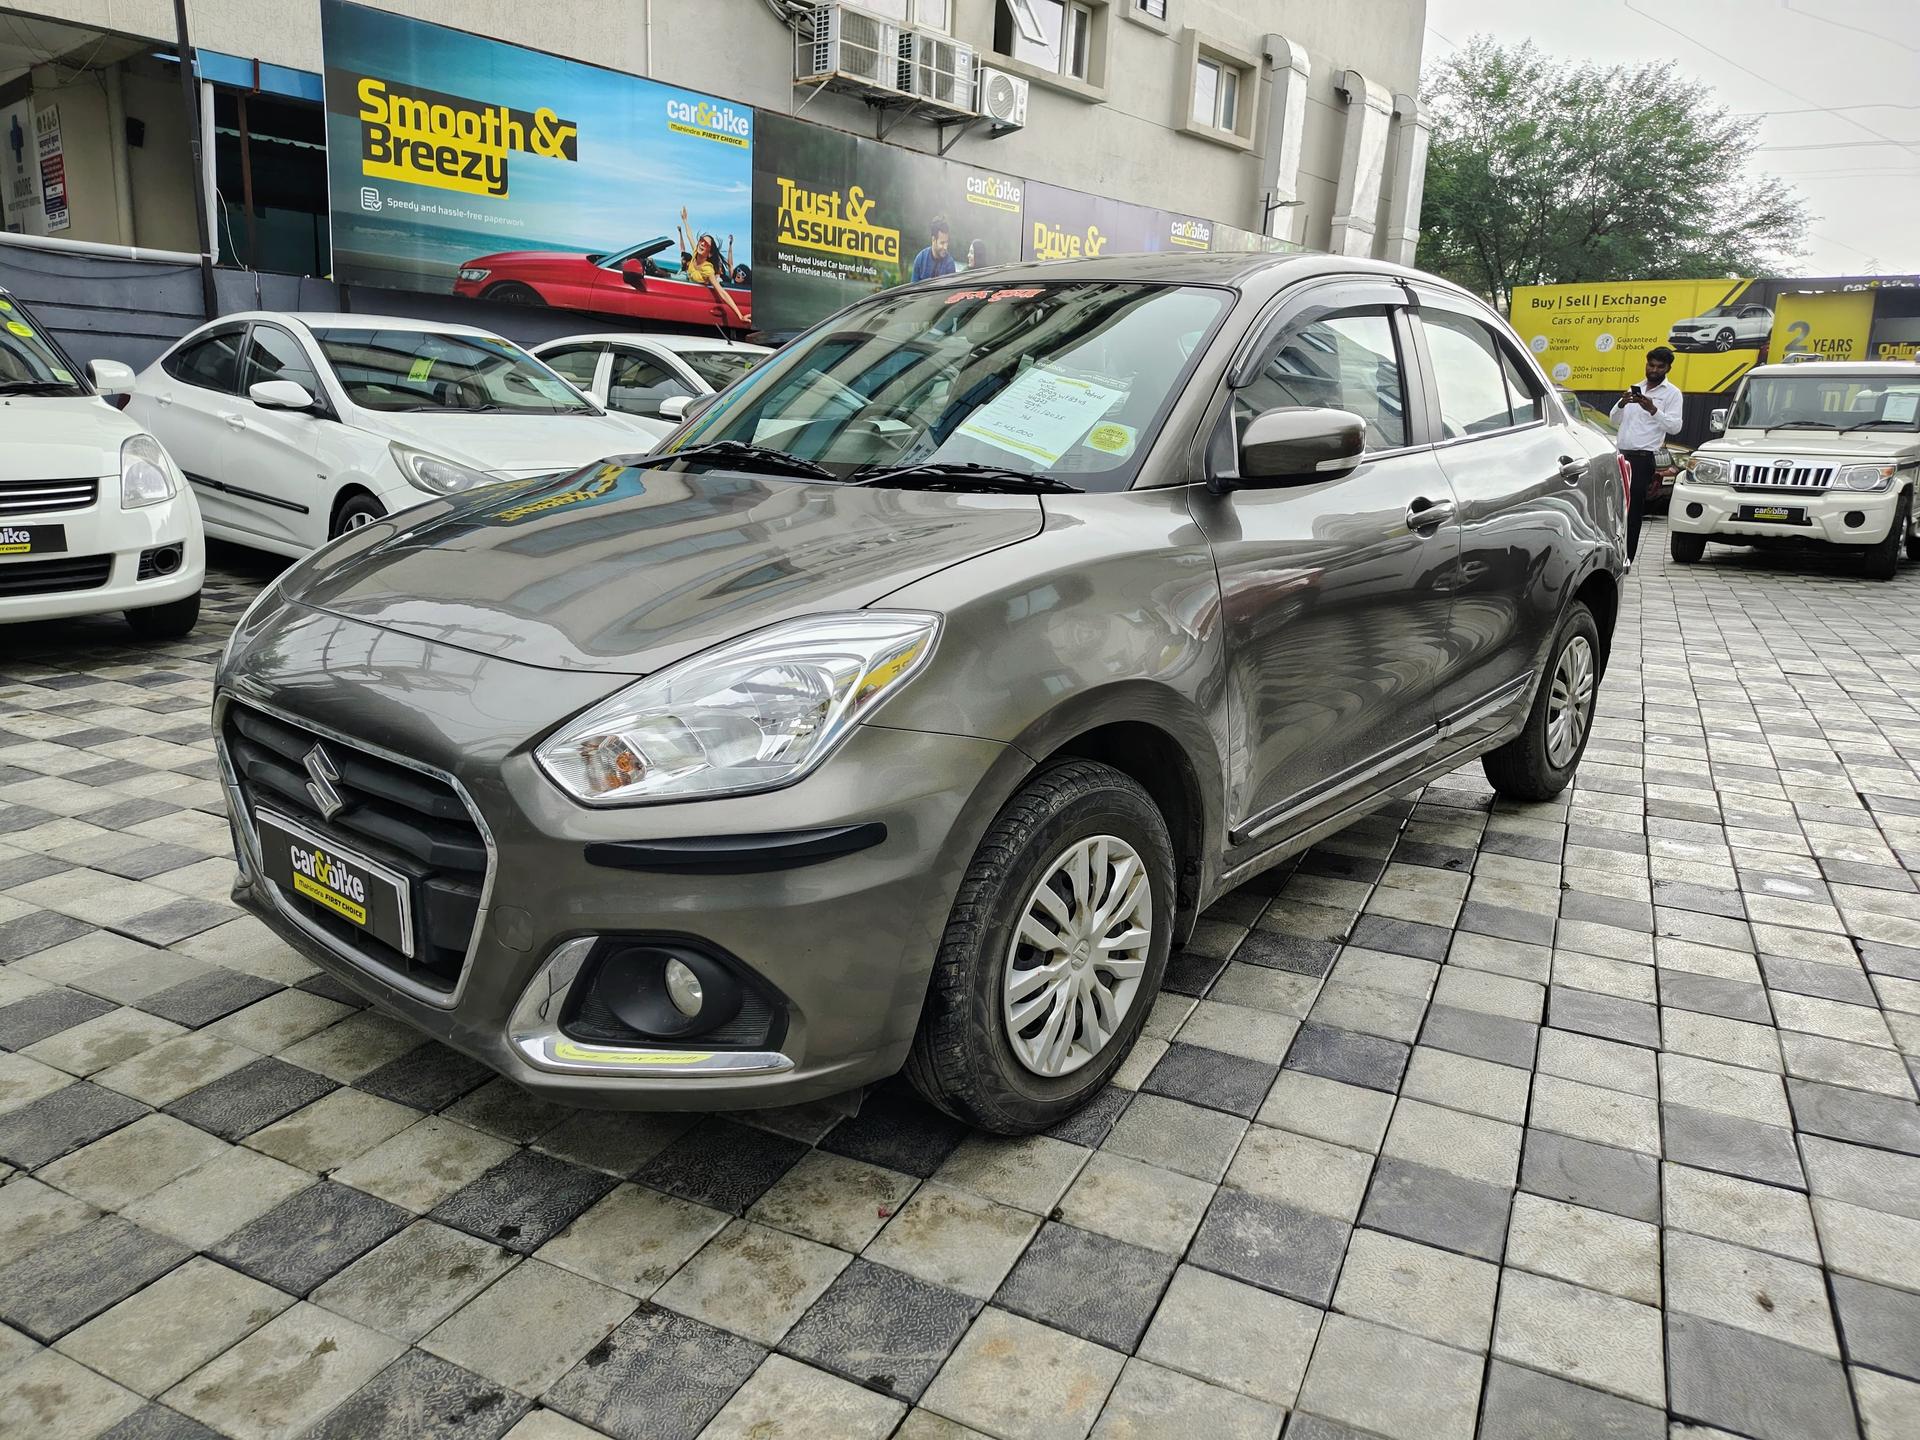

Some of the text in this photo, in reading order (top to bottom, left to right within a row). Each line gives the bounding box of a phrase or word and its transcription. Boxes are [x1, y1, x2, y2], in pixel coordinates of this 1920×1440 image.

[358, 78, 524, 152] Smooth
[666, 100, 749, 136] car&bike
[701, 131, 720, 141] FIRST
[720, 136, 743, 146] CHOICE
[362, 122, 508, 196] Breezy
[777, 177, 875, 225] Trust &
[966, 176, 1021, 203] car&bike
[386, 197, 525, 228] Speedy and hassle-free paperwork
[778, 208, 897, 258] Assurance
[1033, 221, 1081, 257] Drive
[1171, 221, 1210, 242] car&bike
[778, 252, 795, 262] Most
[794, 254, 812, 264] loved
[812, 257, 828, 267] Used
[828, 261, 839, 269] Car
[838, 262, 857, 273] brand
[863, 267, 878, 276] India
[782, 263, 792, 274] By
[791, 266, 821, 277] Franchise
[821, 269, 838, 280] India,
[838, 272, 847, 281] ET
[1531, 297, 1555, 310] Buy
[1565, 295, 1590, 307] Sell
[1601, 294, 1668, 307] Exchange
[1551, 315, 1640, 326] Cars of any brands
[1616, 344, 1645, 352] Buyback
[1617, 336, 1658, 344] Guaranteed
[1784, 320, 1854, 353] 2 YEARS
[1571, 373, 1593, 381] points
[1590, 366, 1626, 374] inspection
[290, 845, 365, 903] car&bike
[325, 894, 341, 907] FIRST
[341, 902, 363, 918] CHOICE
